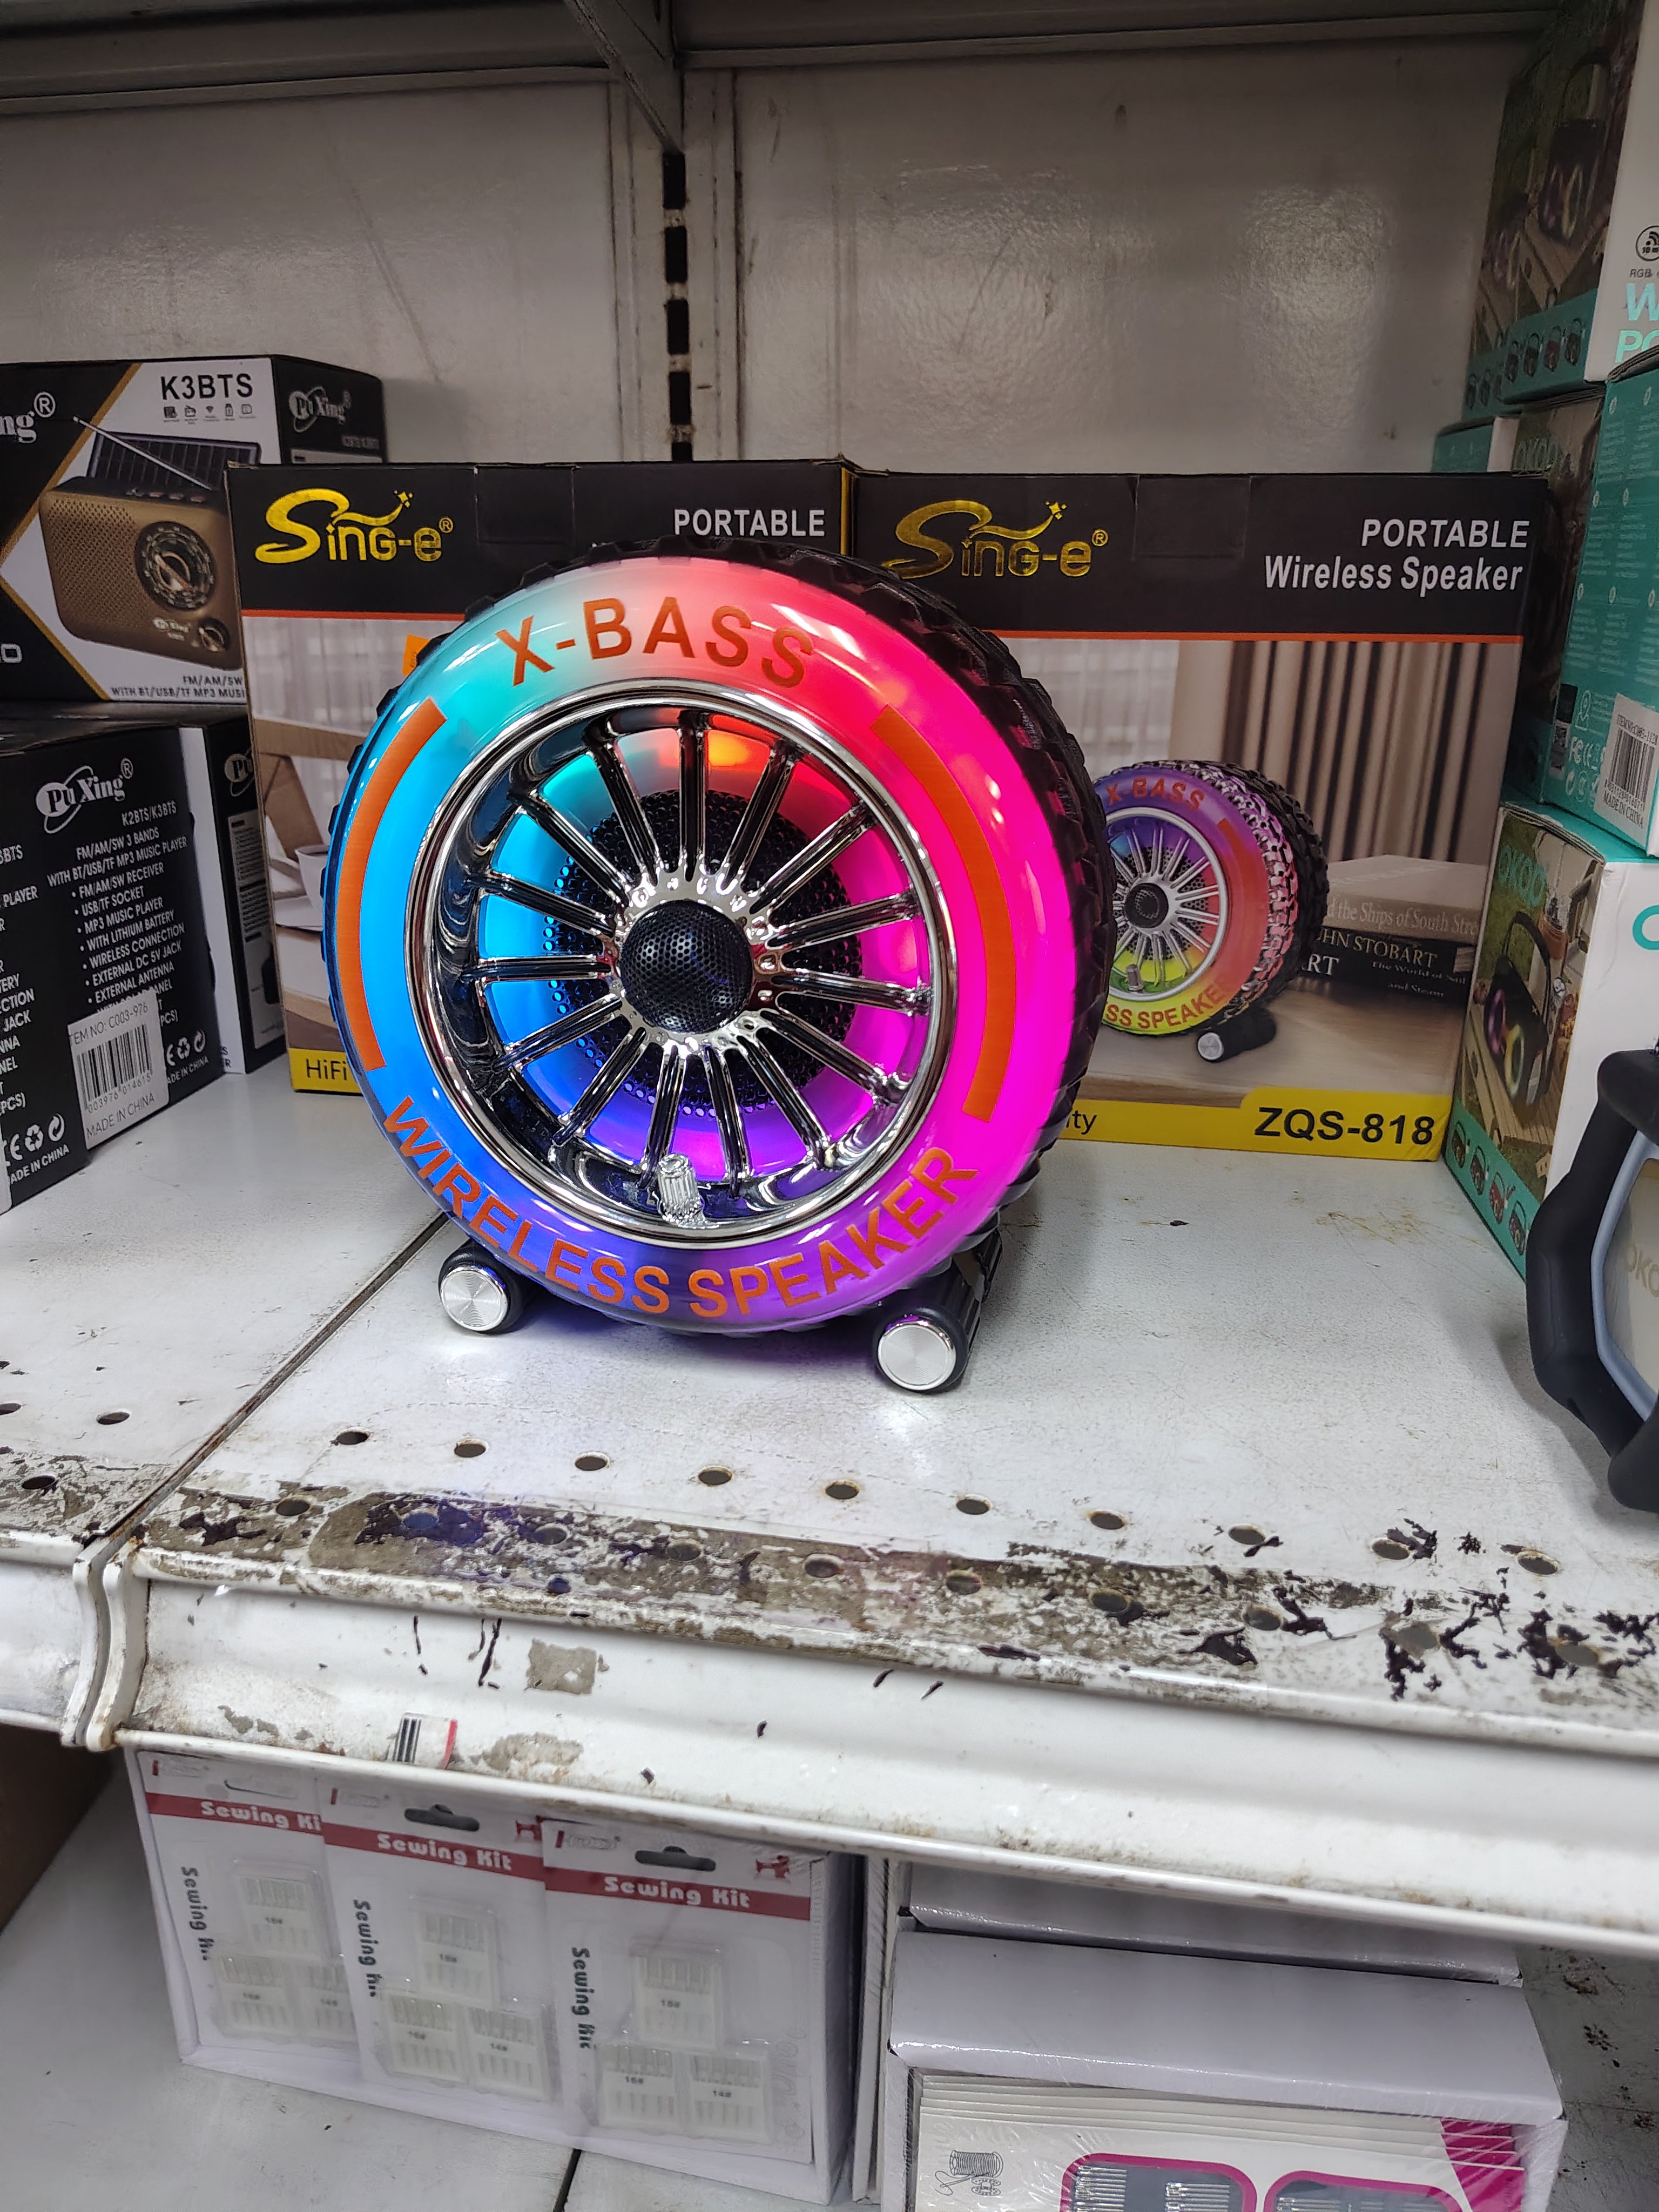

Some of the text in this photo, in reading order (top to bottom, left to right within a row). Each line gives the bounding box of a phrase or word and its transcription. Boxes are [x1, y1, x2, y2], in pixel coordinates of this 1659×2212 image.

[160, 373, 253, 400] K3BTS
[673, 508, 825, 537] PORTABLE
[1361, 518, 1530, 548] PORTABLE
[1265, 555, 1523, 598] Wireless Speaker
[495, 596, 814, 688] X-BASS
[1106, 777, 1205, 811] X-BASS
[121, 800, 177, 827] K2BTS/K3BTS
[46, 835, 187, 887] WITH BT/USB/TF MP3 MUSIC PLAYER
[76, 826, 160, 861] FM/AM/SW 3 BANDS
[3, 885, 39, 908] PLAYER
[78, 861, 165, 900] FM/AM/SW RECEIVER
[81, 885, 145, 917] USB/TF SOCKET
[84, 896, 164, 935] MP3 MUSIC PLAYER
[86, 909, 175, 952] WITH LITHIUM BATTERY
[89, 922, 185, 969] WIRELESS CONNECTION
[92, 939, 183, 987] EXTERNAL DC 5V JACK
[1352, 935, 1438, 969] STOBART
[95, 976, 138, 1004] EXTERNAL
[138, 960, 176, 986] ANTENNA
[0, 988, 35, 1014] CTION
[1105, 1002, 1133, 1027] SS
[3, 1009, 32, 1033] JACK
[90, 1021, 107, 1039] NO:
[167, 1055, 210, 1085] ADE IN CHINA
[306, 1058, 347, 1081] HiFi
[86, 1092, 155, 1138] MADE IN CHINA
[1254, 1106, 1435, 1146] ZQS-818
[10, 1144, 70, 1184] ADE IN CHINA
[383, 1095, 980, 1318] WIRELESS SPEAKER
[200, 1800, 321, 1832] Sewing Ki
[376, 1834, 512, 1872] Sewing Kit
[180, 1866, 207, 1932] Sewing
[603, 1875, 750, 1909] Sewing Kit
[353, 1899, 379, 1967] Sewing
[571, 1946, 596, 2016] Sewing
